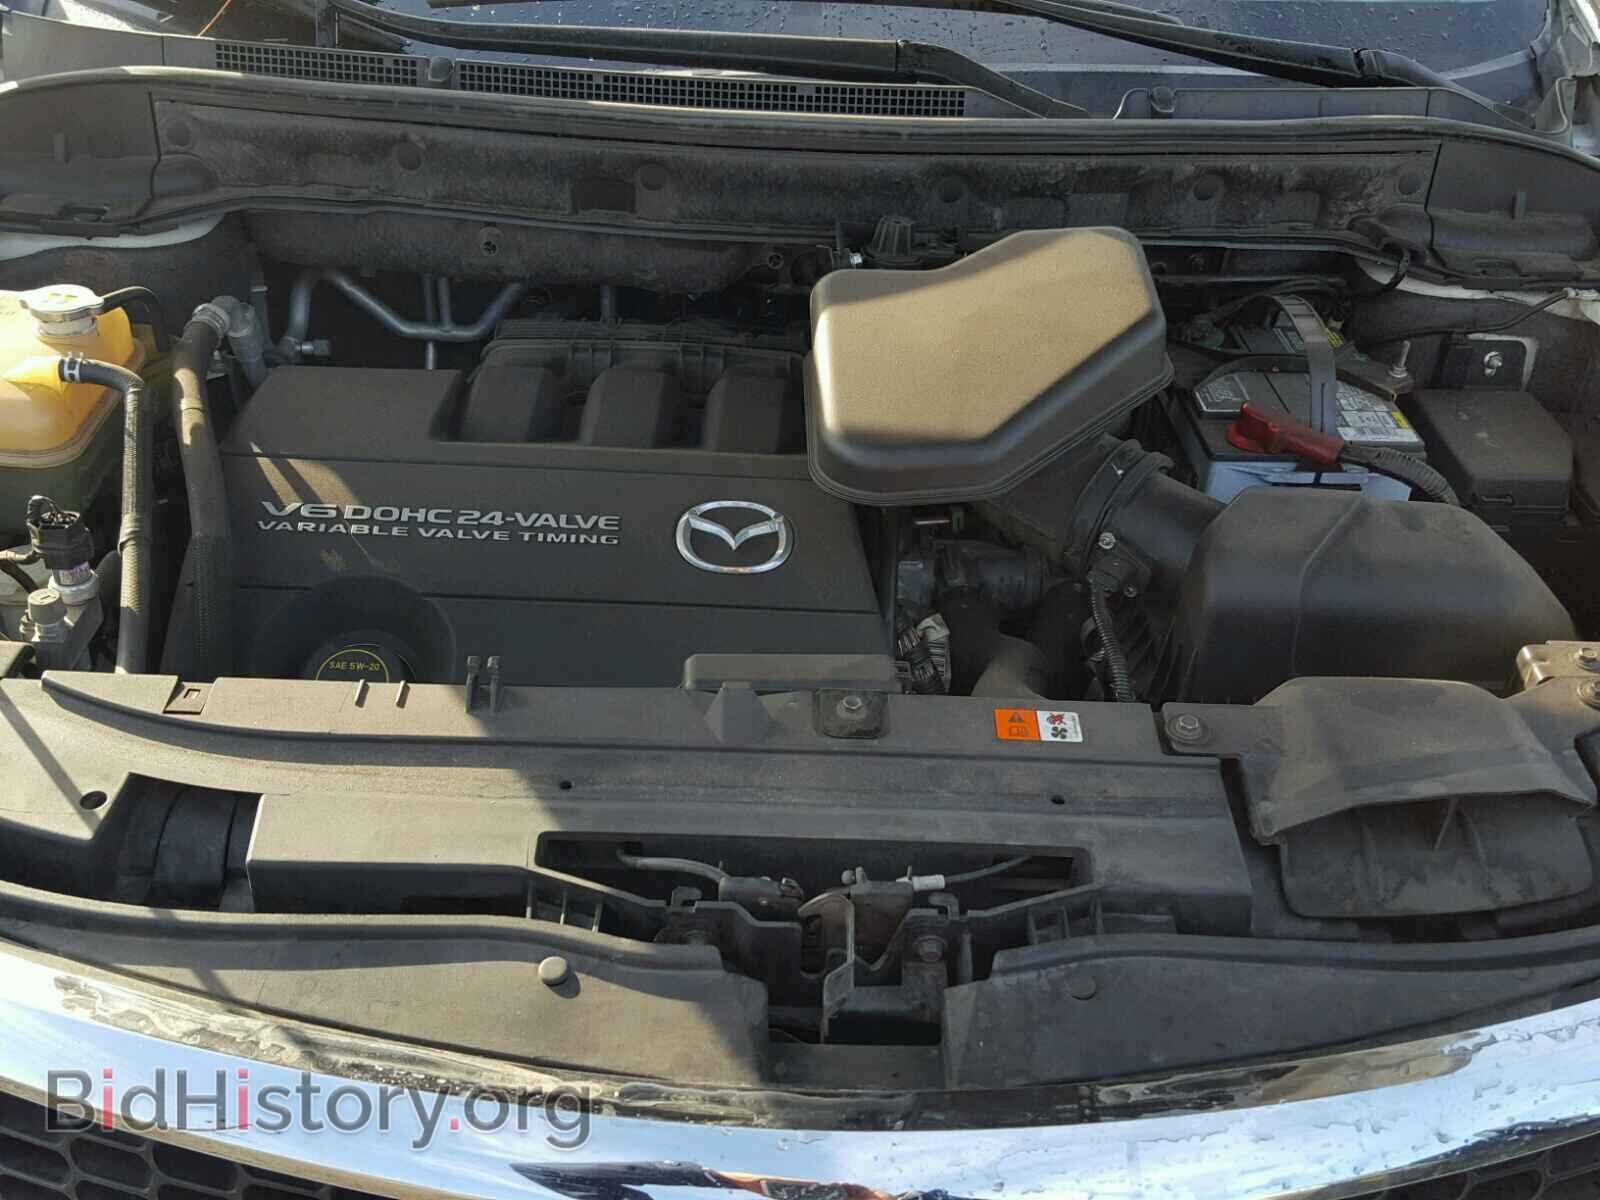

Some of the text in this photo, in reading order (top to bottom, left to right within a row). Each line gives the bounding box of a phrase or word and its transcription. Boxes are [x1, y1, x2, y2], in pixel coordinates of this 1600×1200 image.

[260, 501, 620, 530] V6 DOHC 24-VALVE
[257, 520, 619, 545] VARIABLE VALVE TIMING
[328, 660, 380, 672] SAE 5W-20
